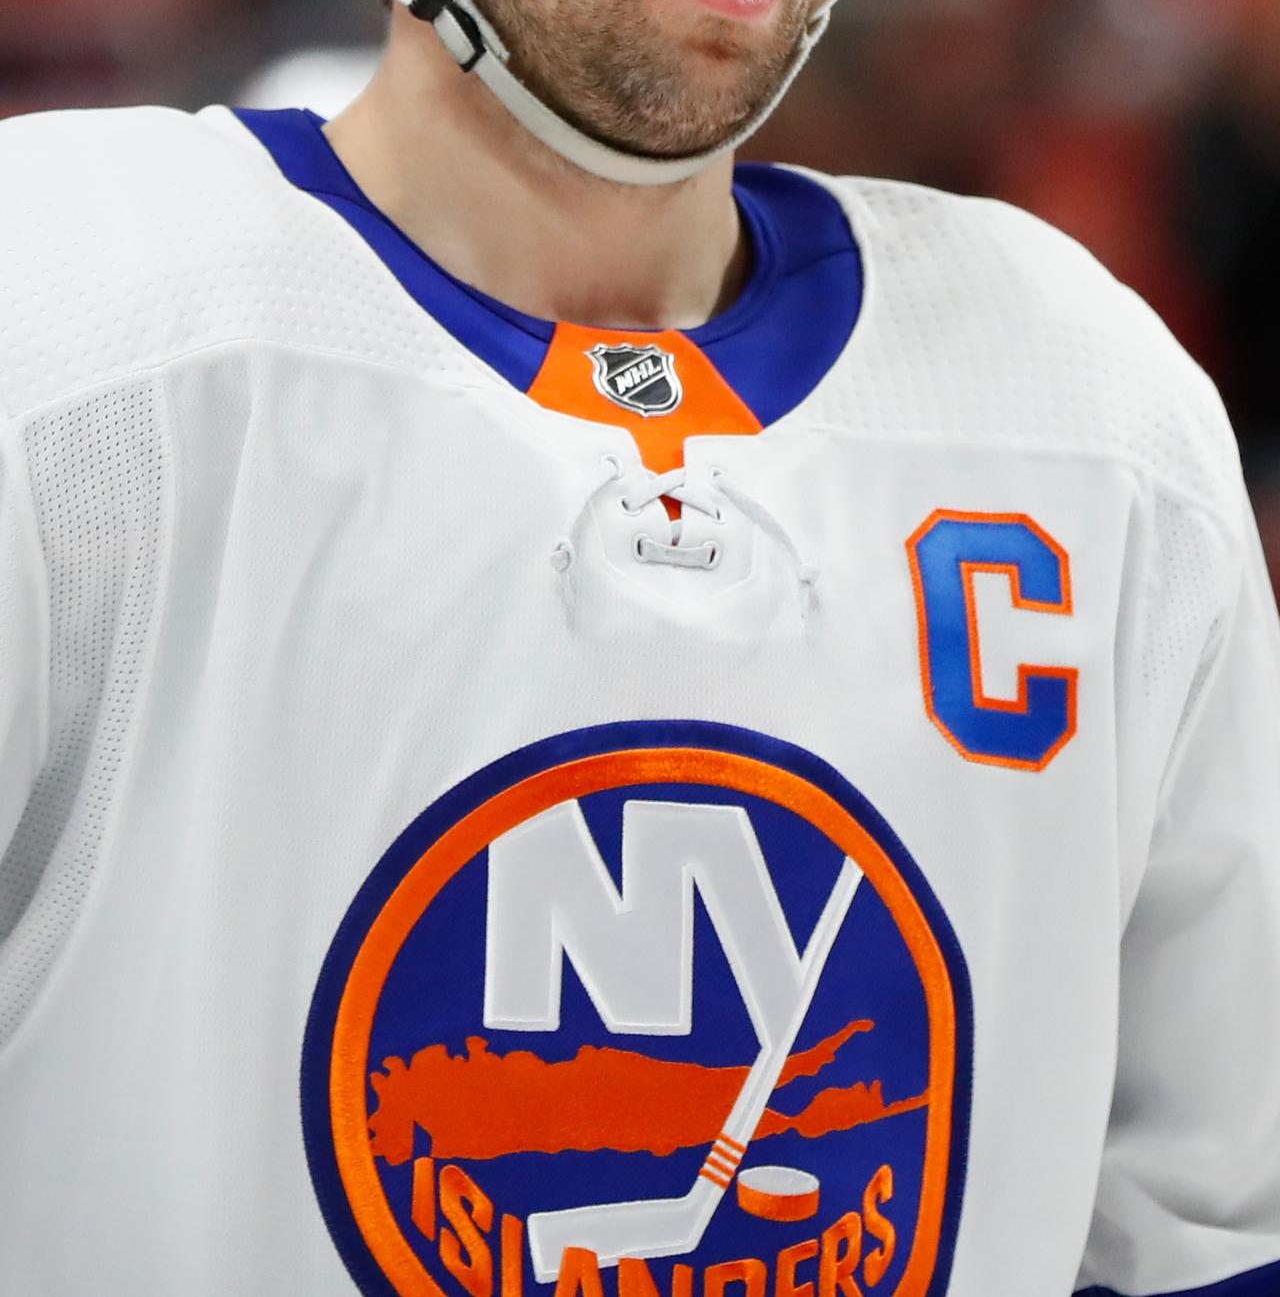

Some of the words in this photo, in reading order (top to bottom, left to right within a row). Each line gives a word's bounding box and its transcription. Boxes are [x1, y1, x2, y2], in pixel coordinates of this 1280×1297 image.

[614, 357, 662, 396] NHL
[905, 508, 1079, 773] C
[483, 798, 866, 1052] NY
